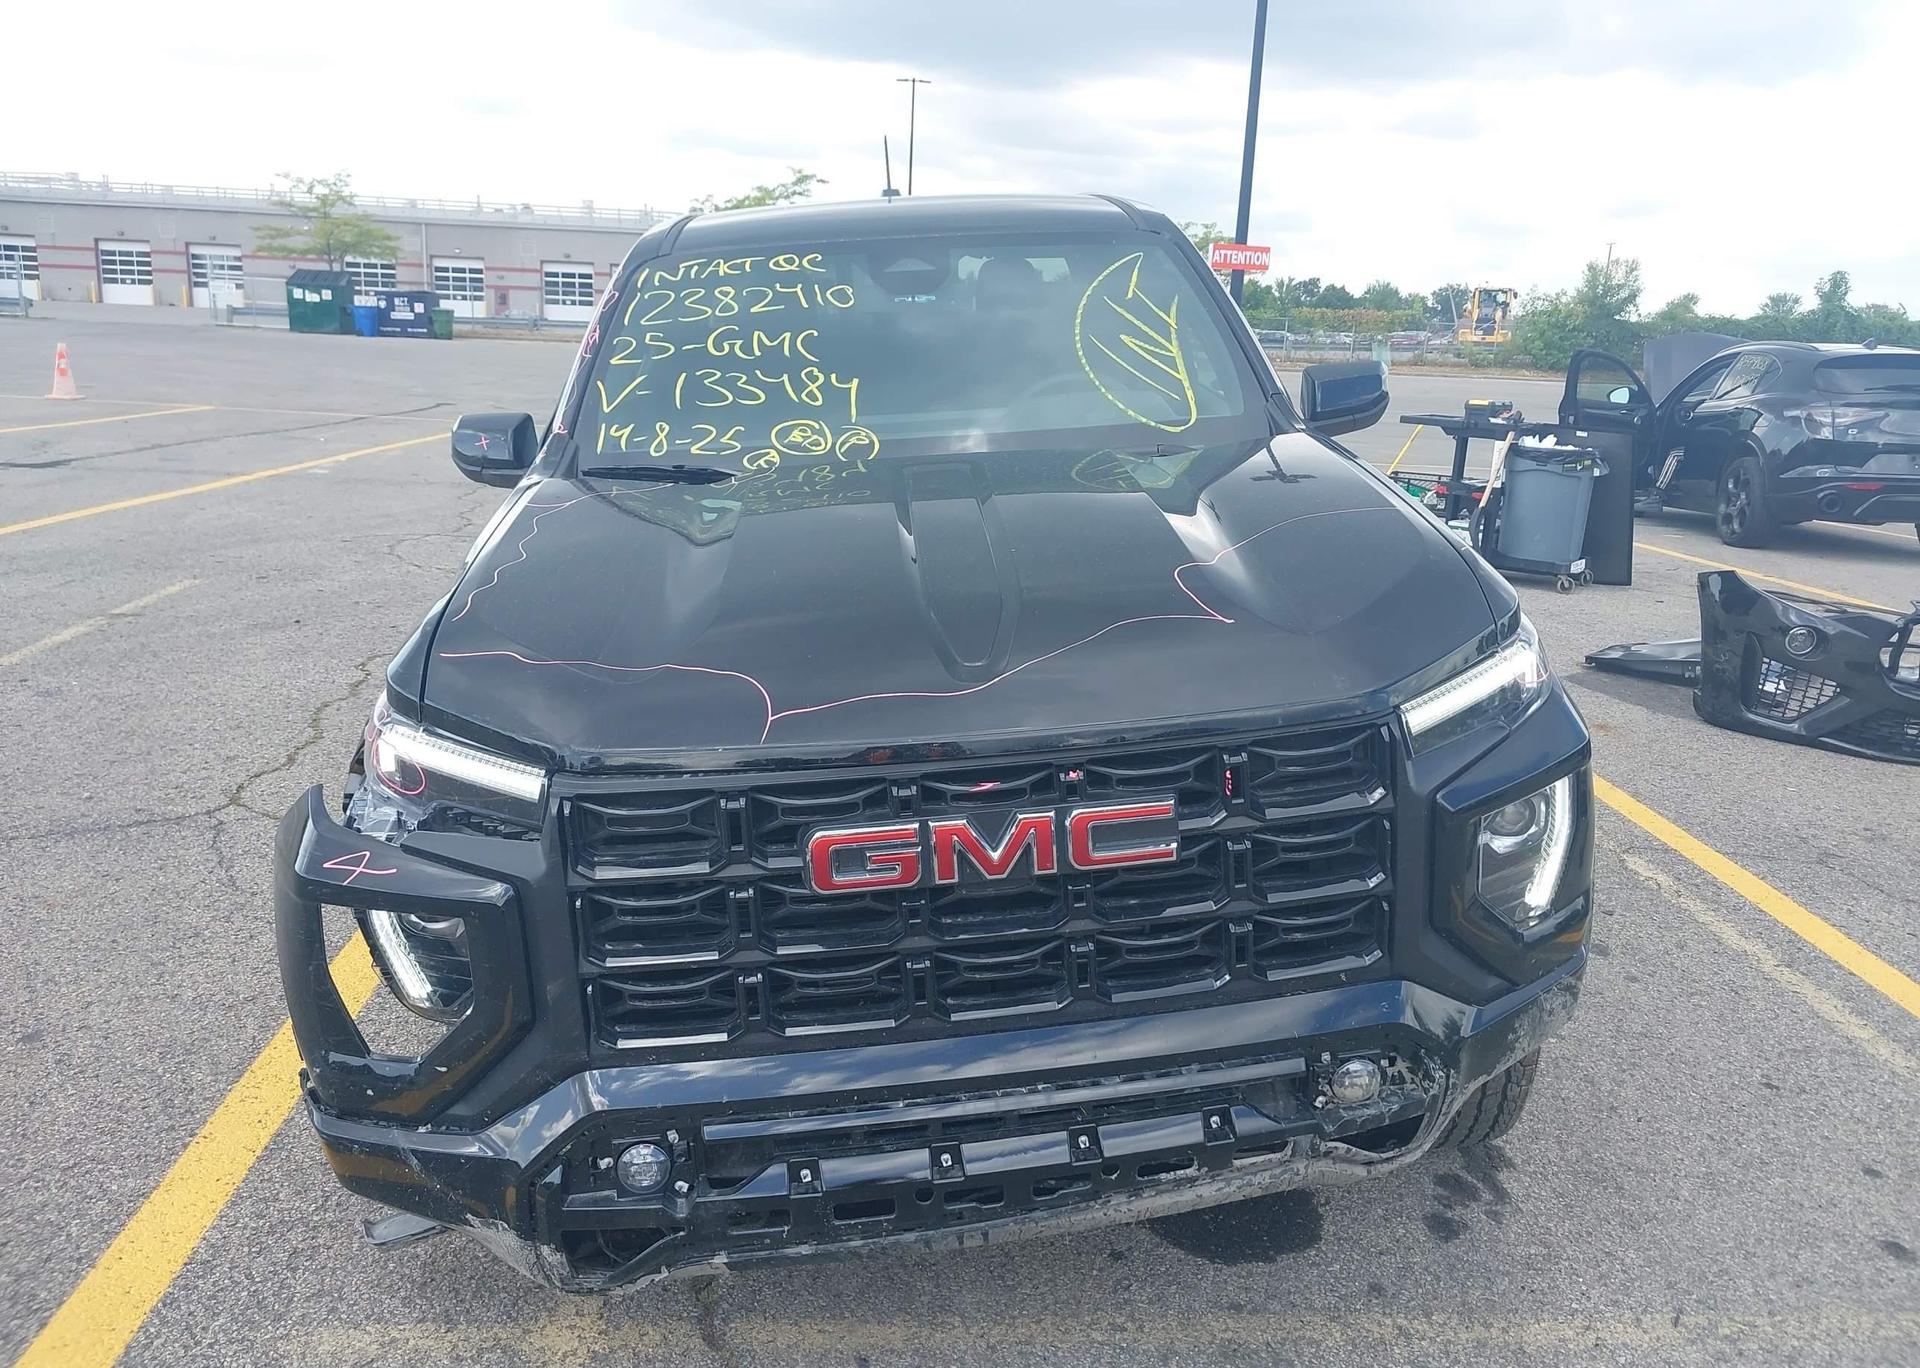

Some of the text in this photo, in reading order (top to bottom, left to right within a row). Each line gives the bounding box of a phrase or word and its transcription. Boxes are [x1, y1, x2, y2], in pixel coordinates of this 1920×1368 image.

[637, 252, 827, 288] INTACT QC
[1212, 248, 1270, 266] ATTENTION
[623, 283, 856, 326] 12382410
[608, 325, 820, 365] 25-GMC
[596, 421, 746, 457] 14-8-25
[805, 799, 1177, 896] GMC
